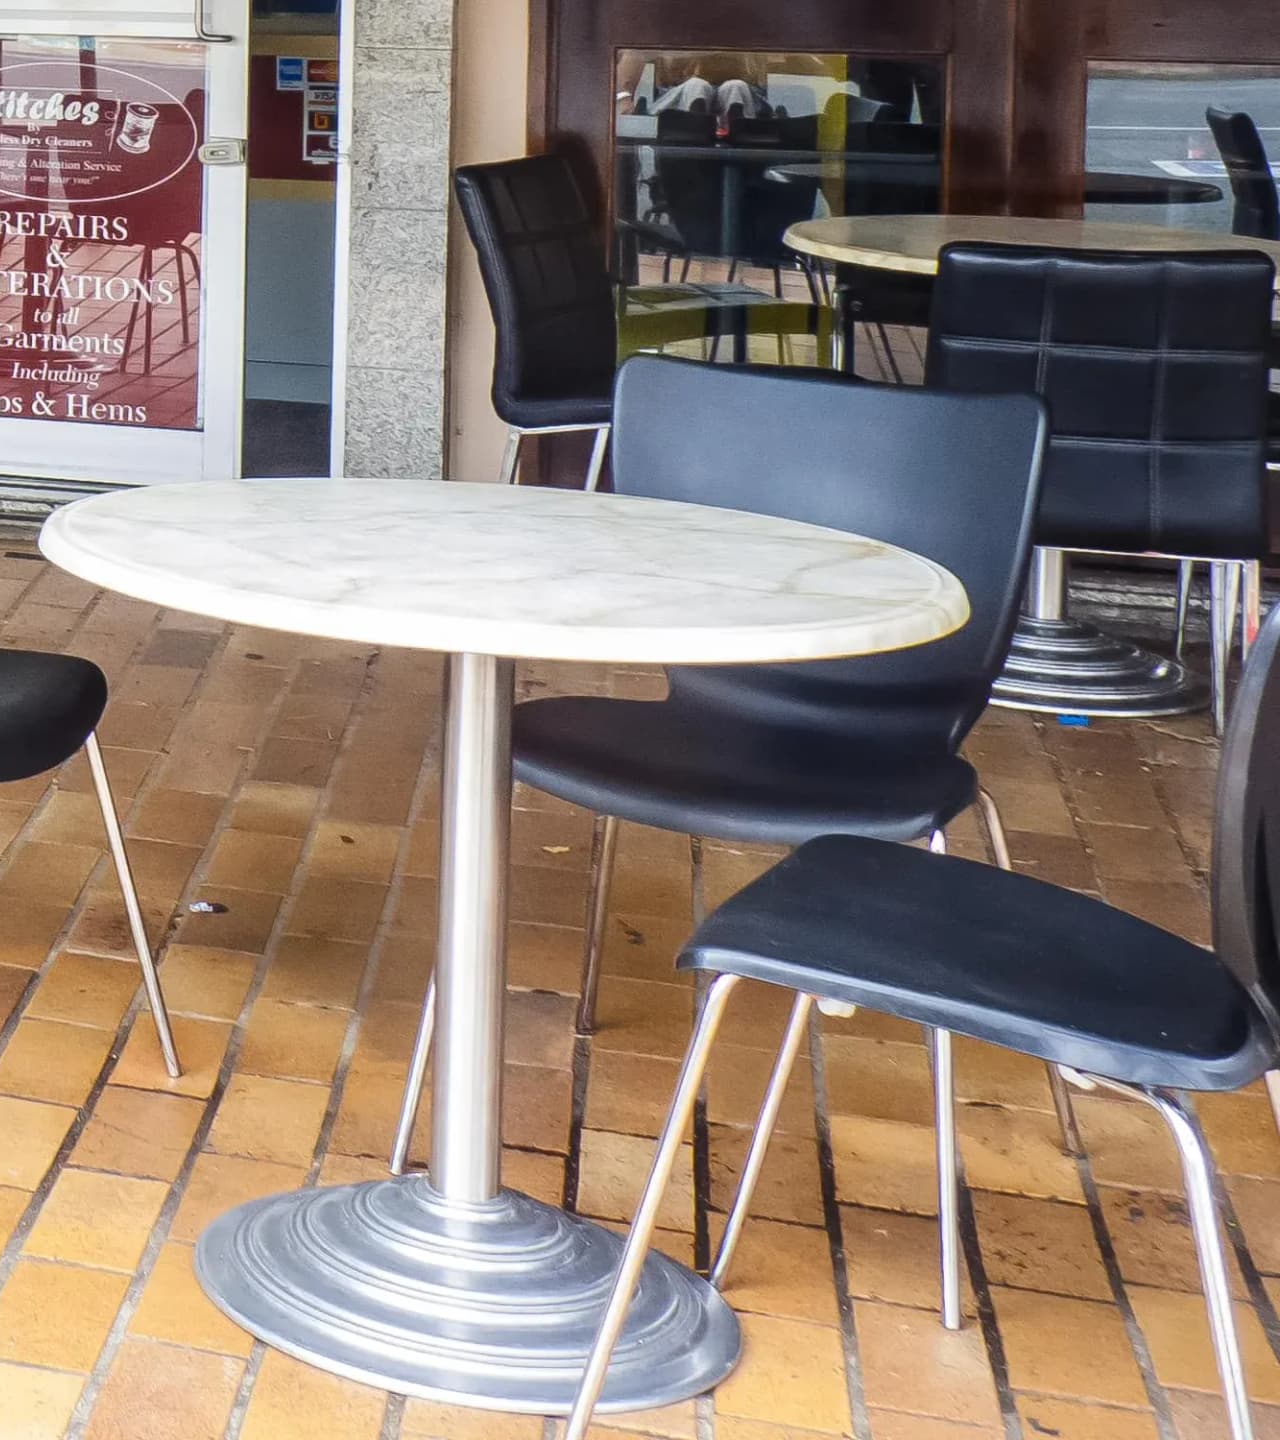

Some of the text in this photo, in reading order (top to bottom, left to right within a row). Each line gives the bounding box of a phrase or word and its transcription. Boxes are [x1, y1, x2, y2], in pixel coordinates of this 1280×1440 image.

[22, 135, 41, 147] Dry
[45, 136, 93, 147] Cleaners
[83, 160, 122, 172] Service
[46, 240, 71, 268] &
[33, 307, 79, 325] to all
[11, 362, 101, 389] Including
[31, 391, 56, 417] &
[66, 393, 147, 423] Hems
